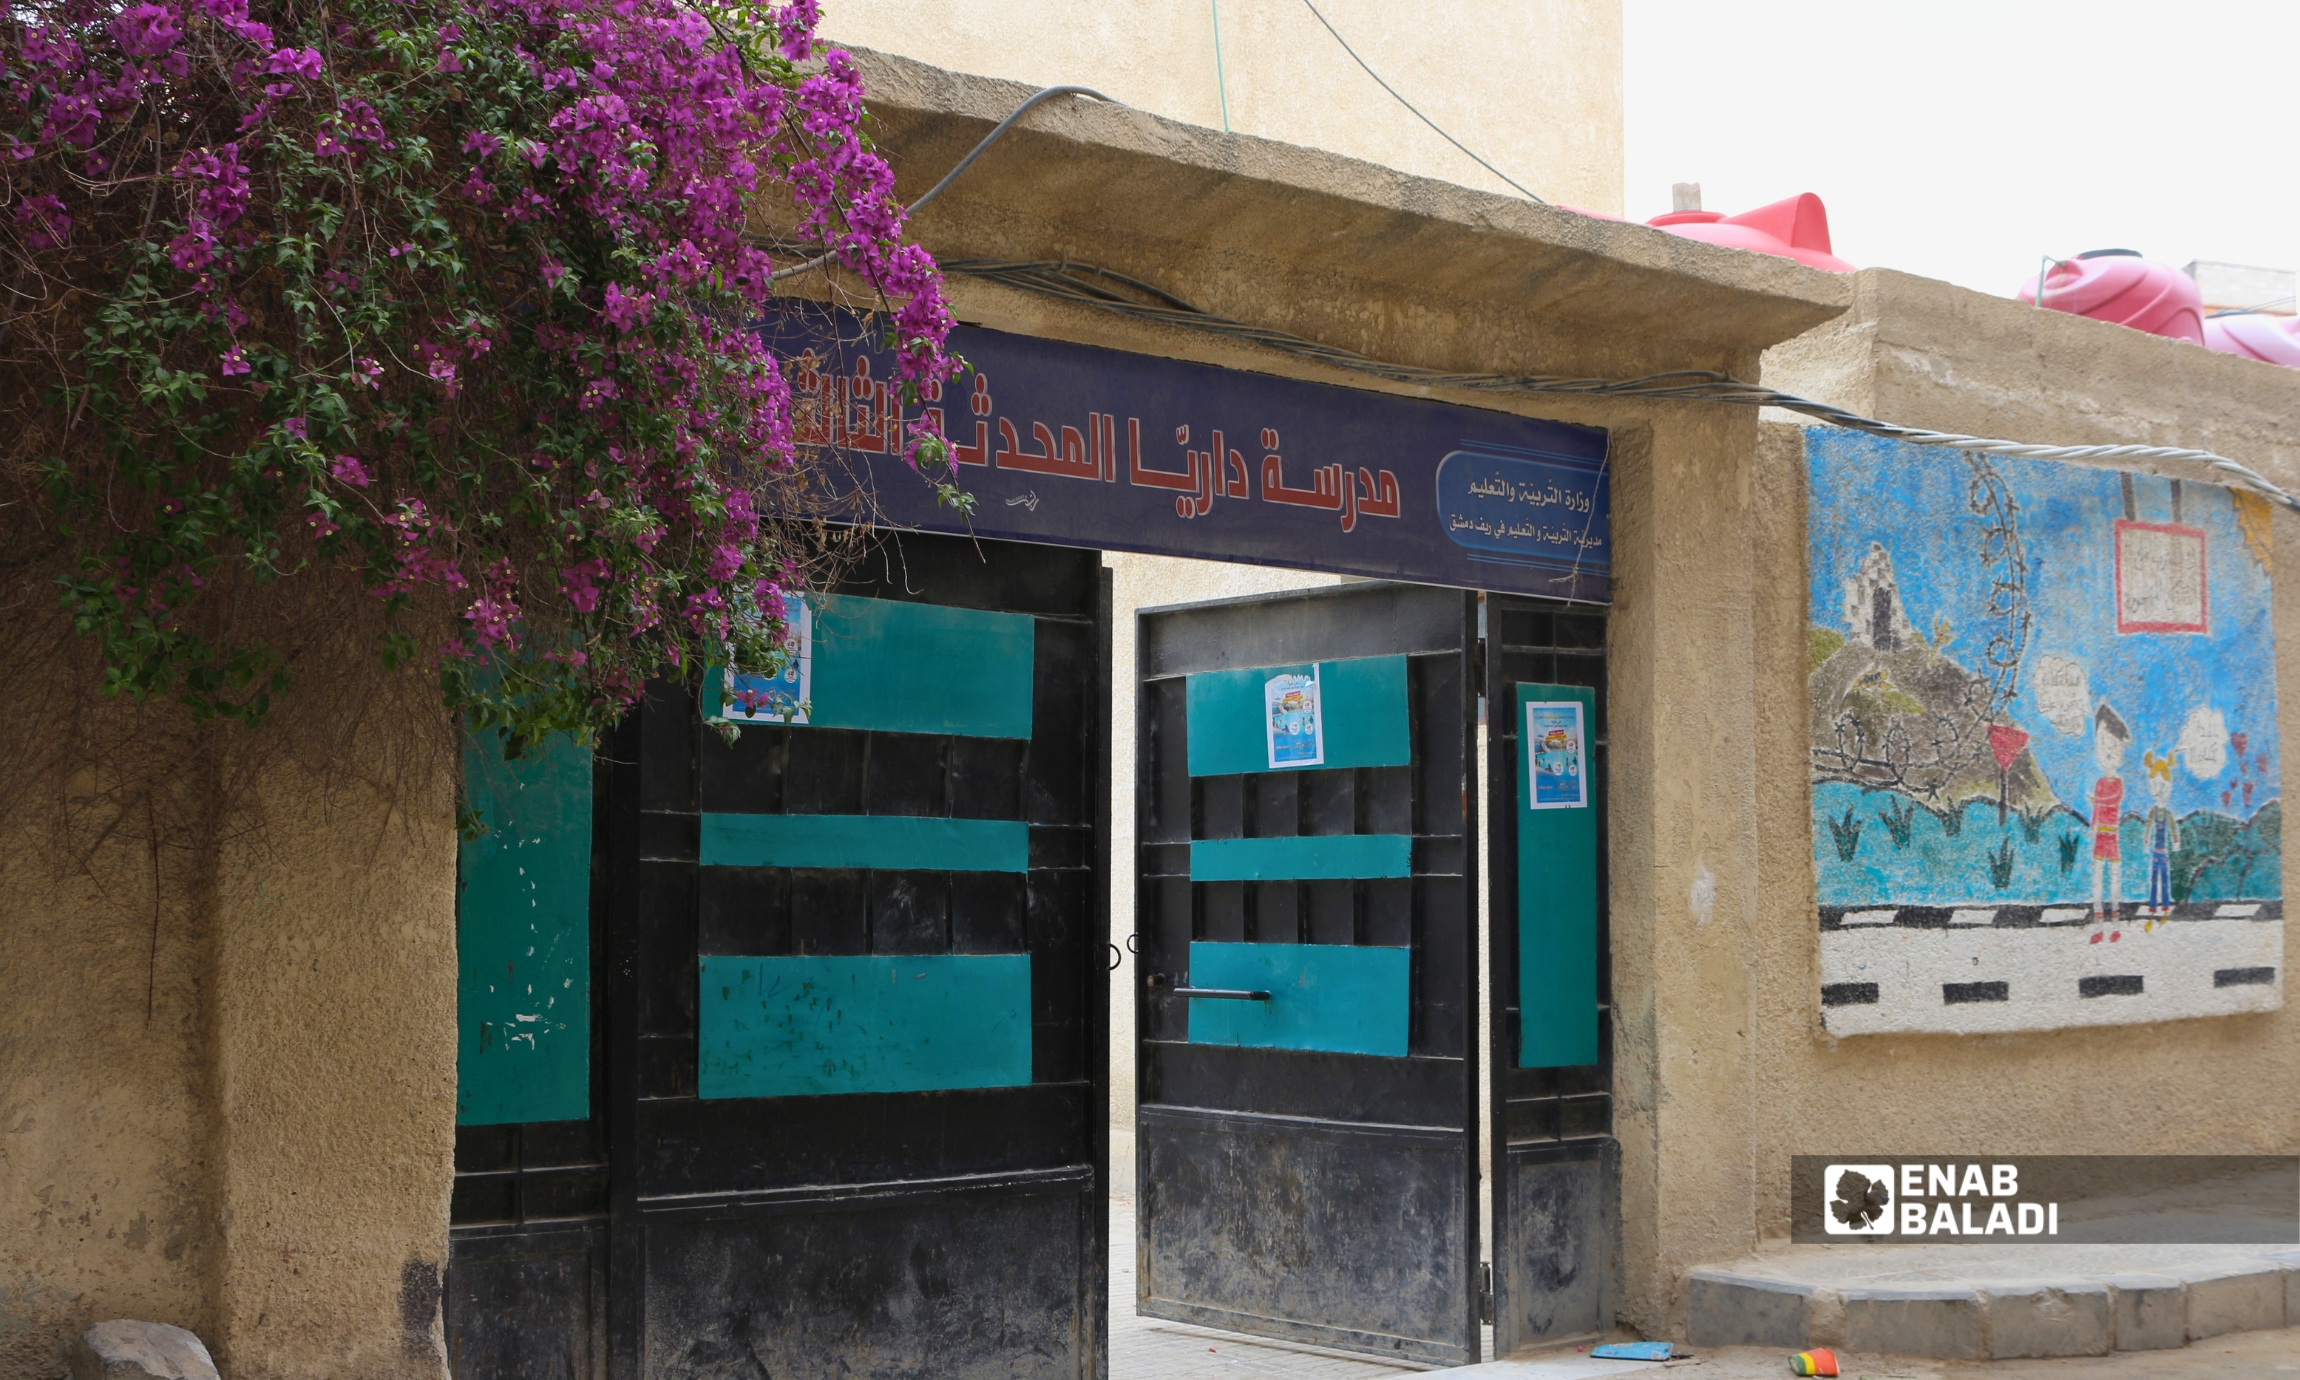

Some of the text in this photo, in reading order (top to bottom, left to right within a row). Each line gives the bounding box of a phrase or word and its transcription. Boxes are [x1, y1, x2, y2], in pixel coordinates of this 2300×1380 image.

[1261, 428, 1401, 533] مدرسة
[1564, 488, 1591, 513] وزارة
[1449, 513, 1474, 532] دمشق
[1475, 516, 1493, 535] ريف
[1494, 519, 1506, 539] في
